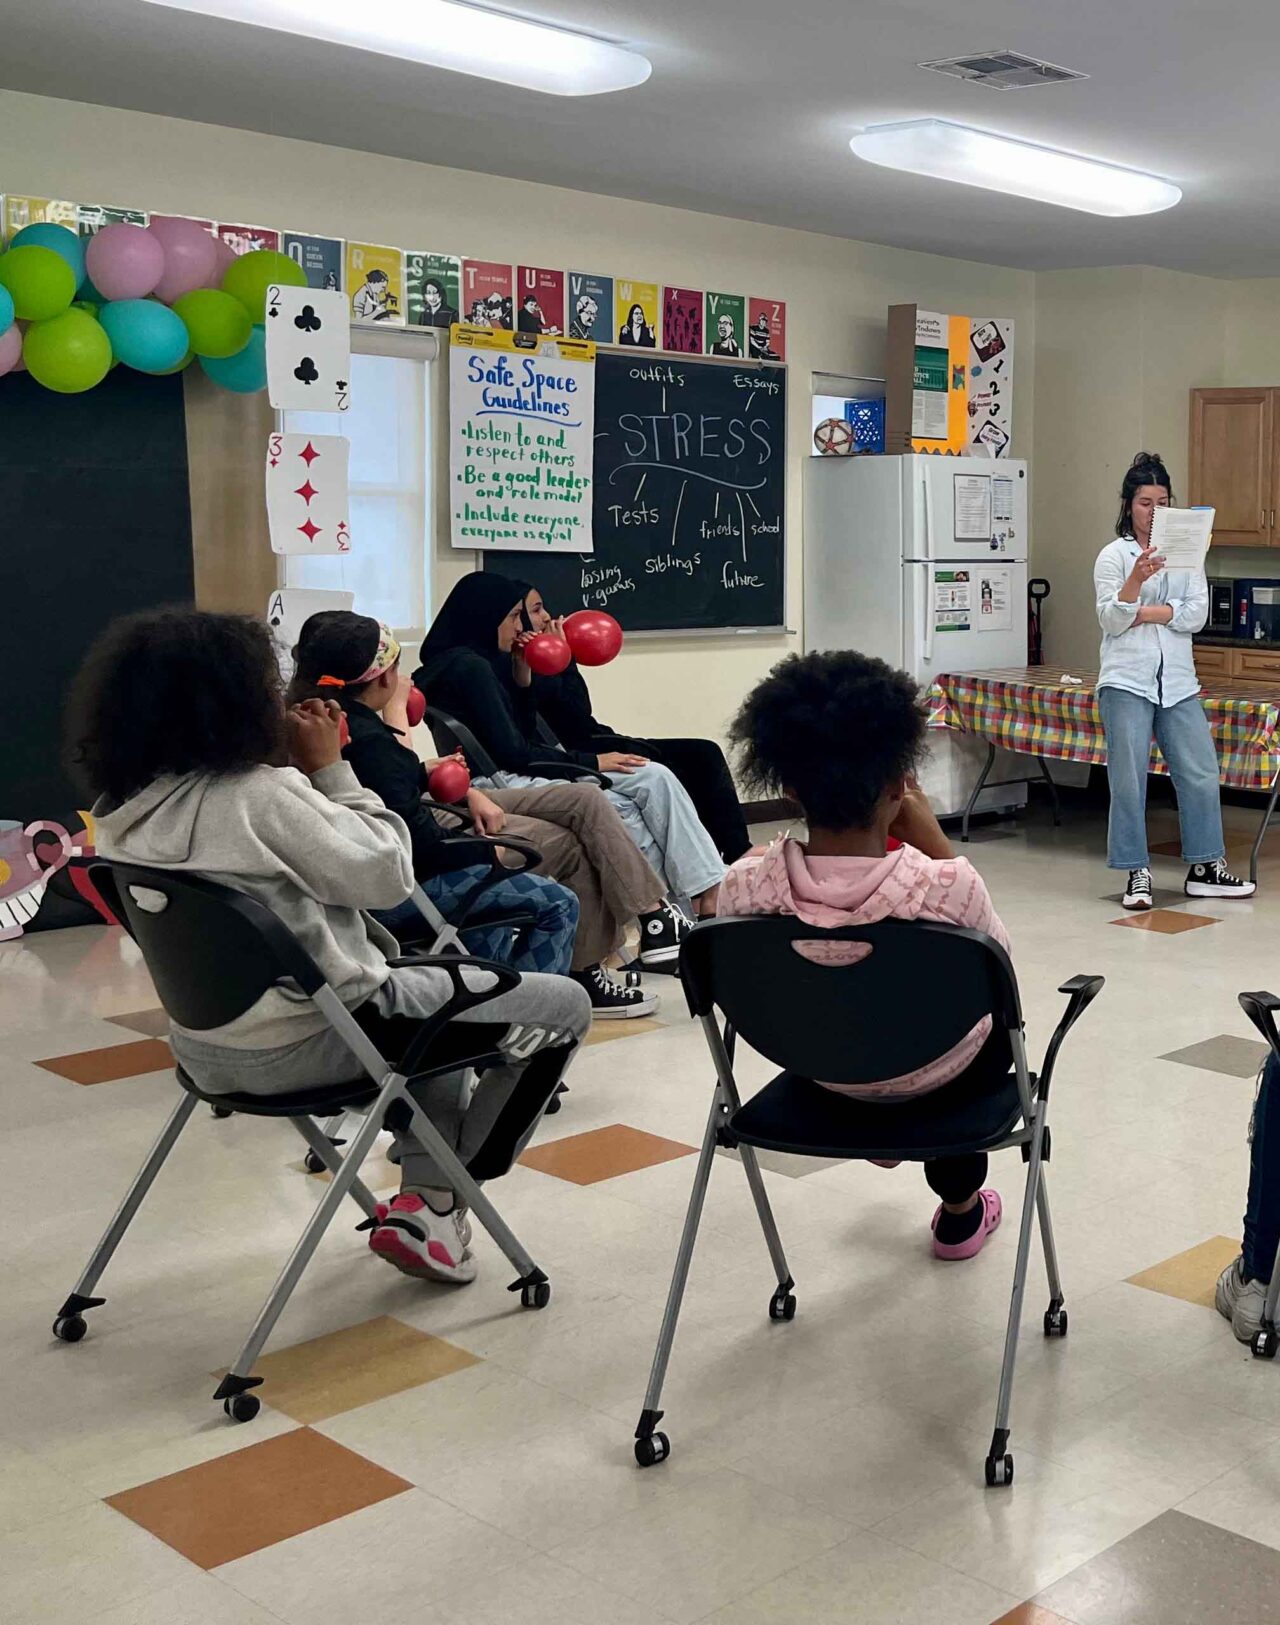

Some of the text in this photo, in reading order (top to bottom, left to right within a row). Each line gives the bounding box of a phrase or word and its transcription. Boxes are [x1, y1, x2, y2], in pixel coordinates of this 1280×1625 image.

[412, 257, 424, 277] S
[465, 267, 478, 289] T
[525, 268, 537, 289] U
[571, 276, 582, 295] V
[269, 286, 282, 306] 2
[620, 283, 632, 301] W
[671, 289, 679, 301] X
[708, 294, 719, 315] Y
[772, 304, 780, 322] Z
[993, 359, 1004, 374] 1
[467, 355, 577, 399] Safe Space
[733, 374, 780, 396] Essays
[989, 381, 1000, 396] 2
[334, 392, 348, 411] 2
[482, 387, 570, 417] Guidelines
[989, 403, 1000, 417] 3
[467, 420, 567, 449] Listen to and
[618, 412, 772, 465] STRESS
[270, 436, 283, 456] 3
[466, 445, 575, 467] respect others
[464, 464, 591, 491] Be a good leader
[476, 485, 583, 503] and role model
[464, 502, 519, 522] Include
[608, 500, 659, 527] Tests
[461, 526, 518, 542] everyone
[538, 528, 572, 544] equal
[699, 513, 740, 540] friends
[337, 532, 350, 551] 3
[720, 560, 765, 589] future
[271, 594, 284, 616] A
